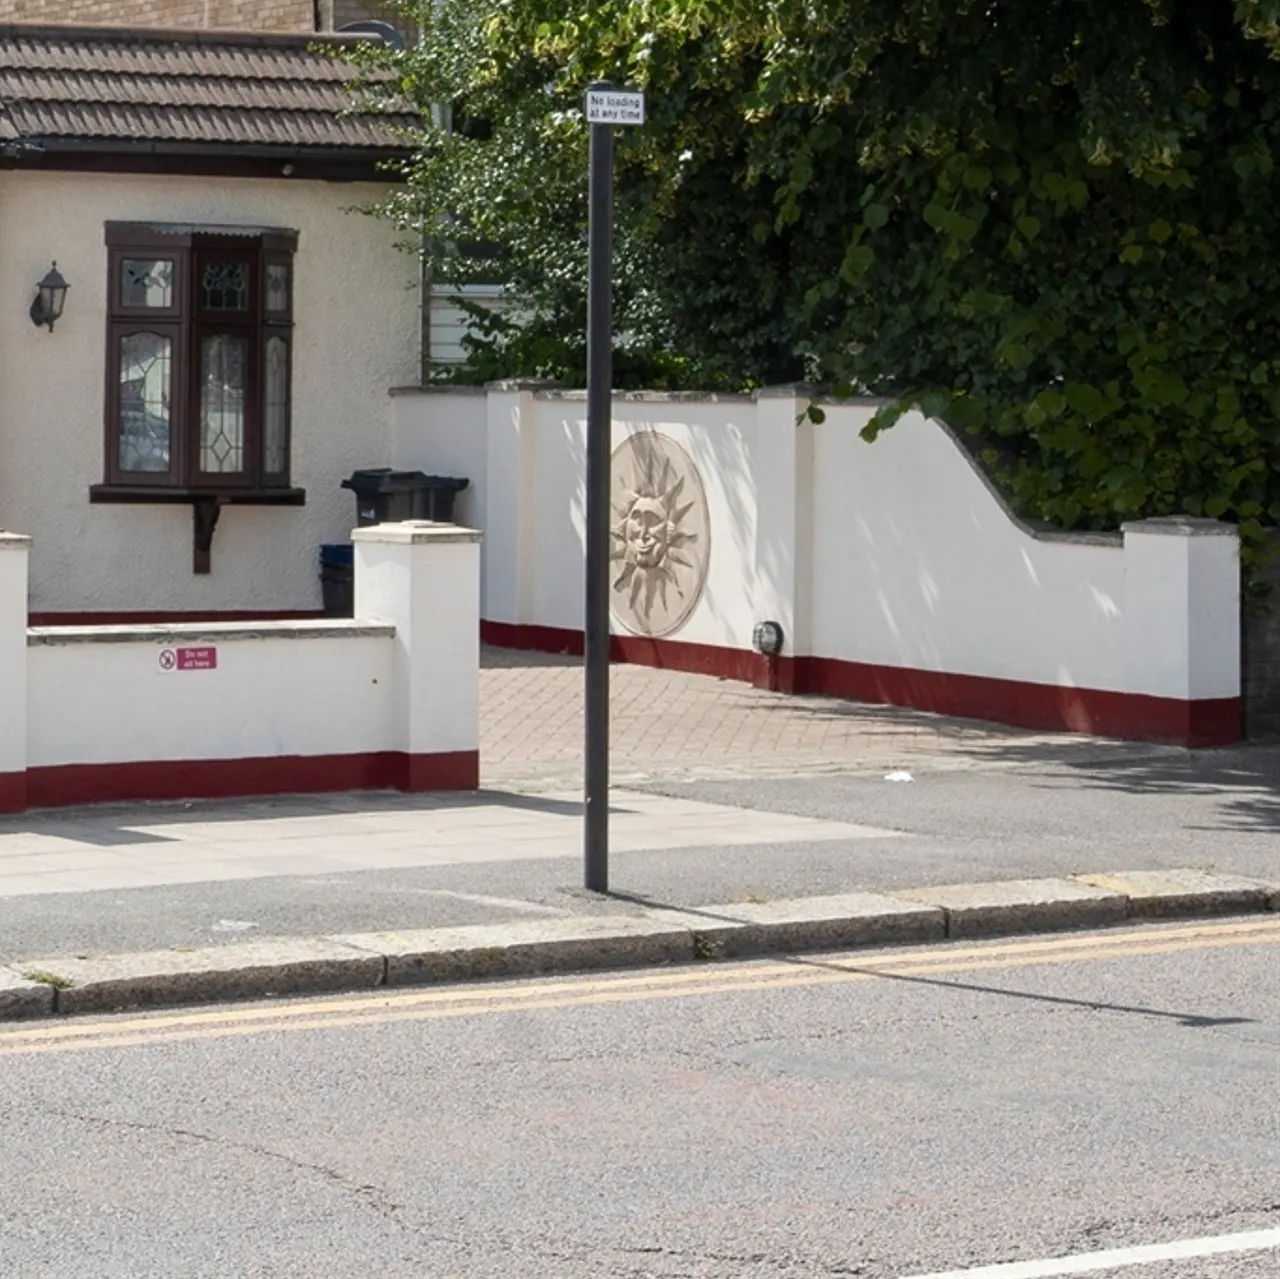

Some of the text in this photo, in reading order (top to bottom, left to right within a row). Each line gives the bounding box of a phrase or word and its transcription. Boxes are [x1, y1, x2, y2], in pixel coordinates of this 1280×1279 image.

[591, 95, 640, 108] No loading
[590, 109, 640, 120] at any time
[185, 650, 208, 658] Do not
